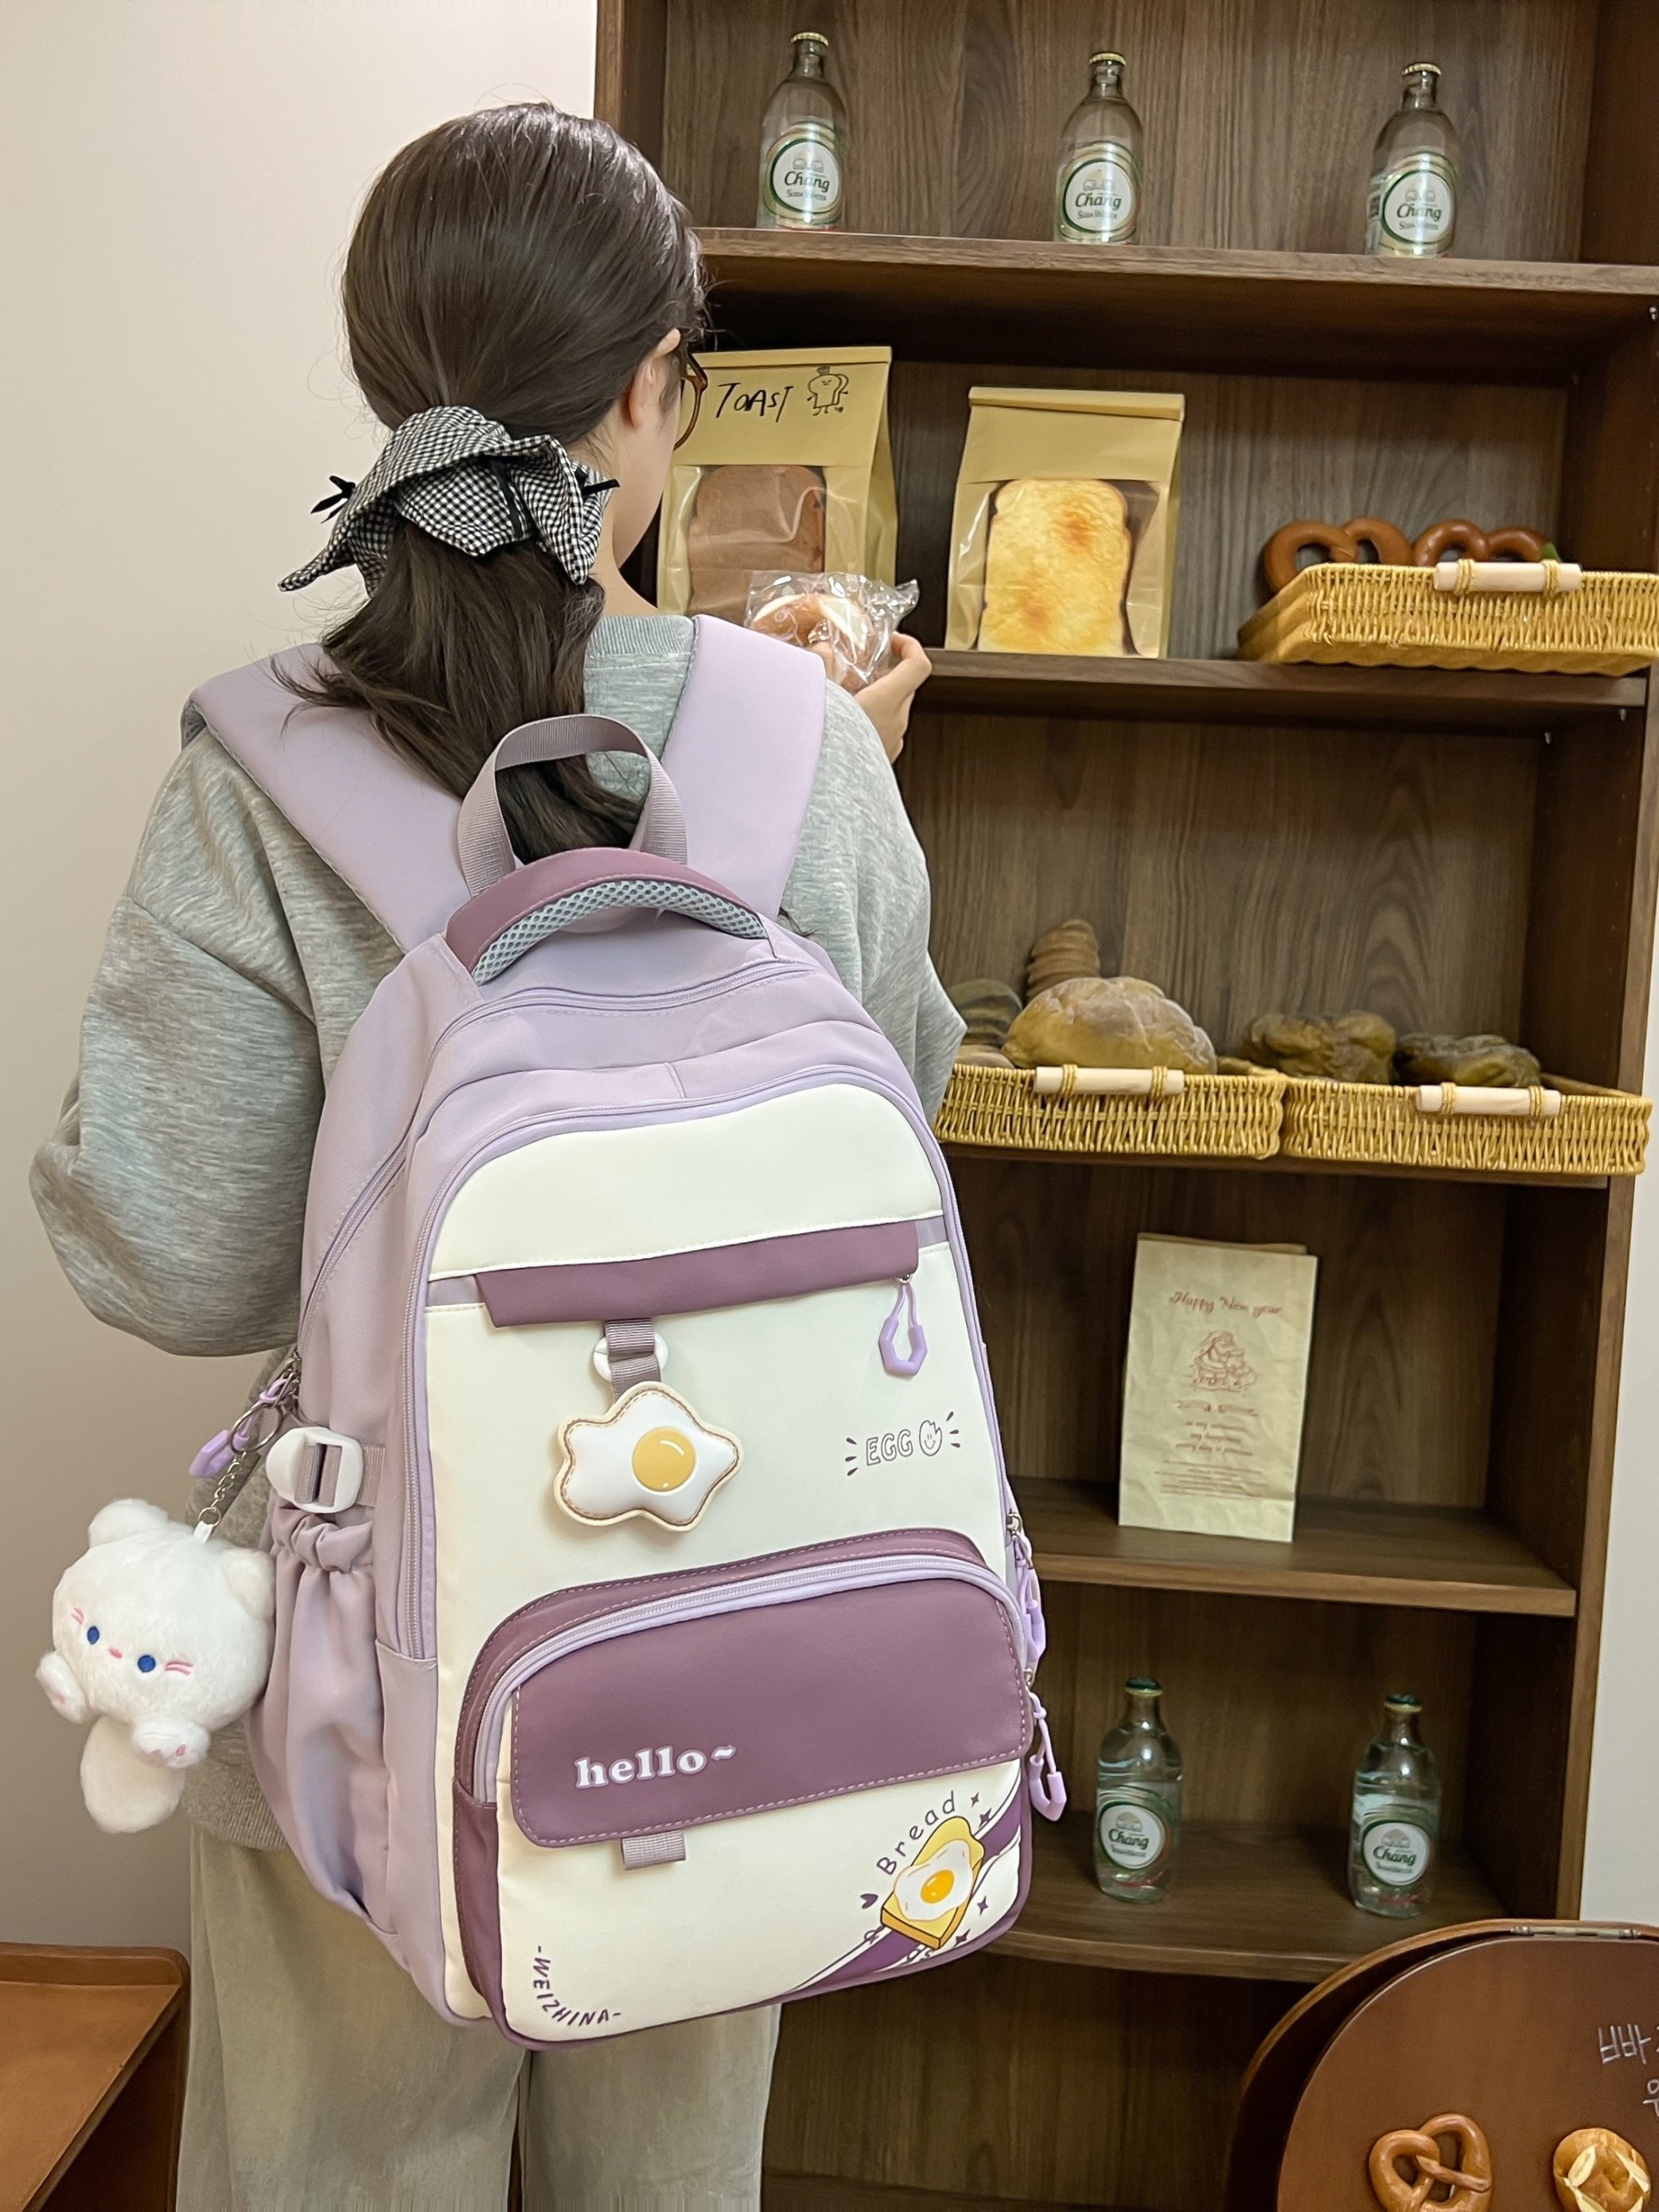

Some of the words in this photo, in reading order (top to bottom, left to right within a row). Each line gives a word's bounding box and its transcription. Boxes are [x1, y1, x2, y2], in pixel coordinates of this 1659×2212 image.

[784, 170, 830, 193] Chang
[1075, 193, 1122, 211] Chang
[1168, 1291, 1214, 1314] Happy
[866, 1428, 913, 1466] EGG
[876, 1790, 956, 1875] Bread
[1108, 1828, 1149, 1850] Chang
[1373, 1845, 1417, 1867] Chang
